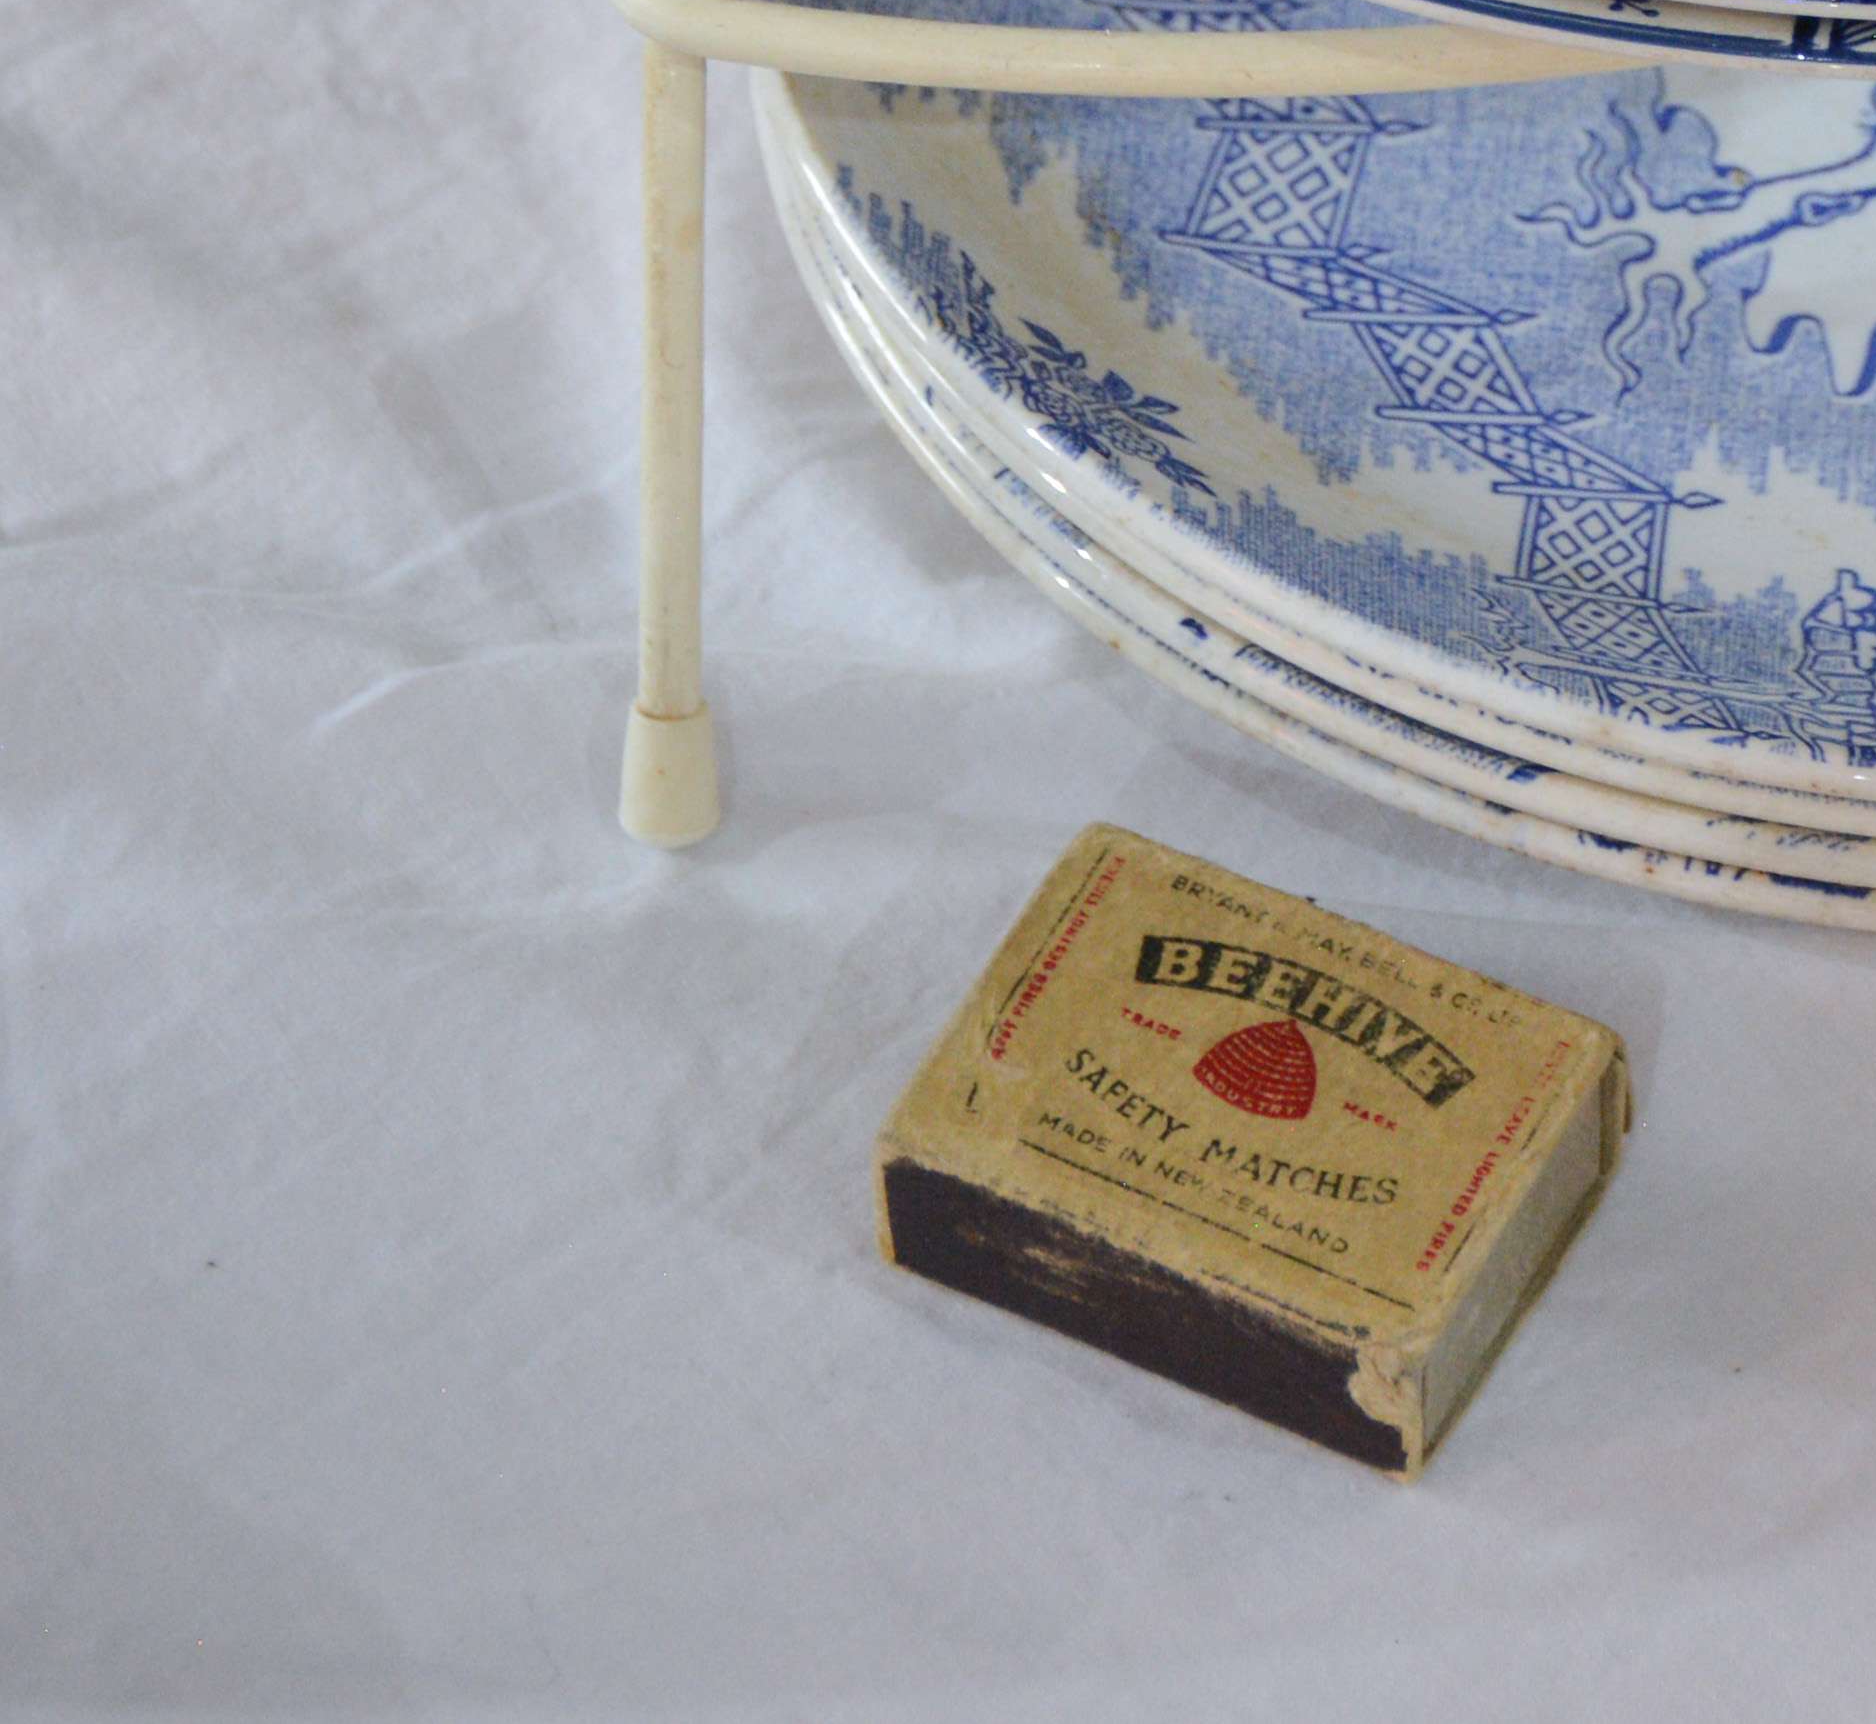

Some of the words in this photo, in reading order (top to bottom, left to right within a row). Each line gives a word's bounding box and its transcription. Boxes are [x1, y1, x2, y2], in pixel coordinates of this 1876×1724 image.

[1121, 1006, 1182, 1040] TRADE
[1342, 1101, 1398, 1132] MARK
[1148, 937, 1460, 1101] BEEHIVE
[1038, 1112, 1112, 1153] MADE
[1119, 1146, 1147, 1167] IN
[1154, 1160, 1207, 1193] NEW
[1215, 1188, 1350, 1254] ZEALAND
[1065, 1048, 1190, 1143] SAFETY
[1198, 1139, 1399, 1205] MATCHES
